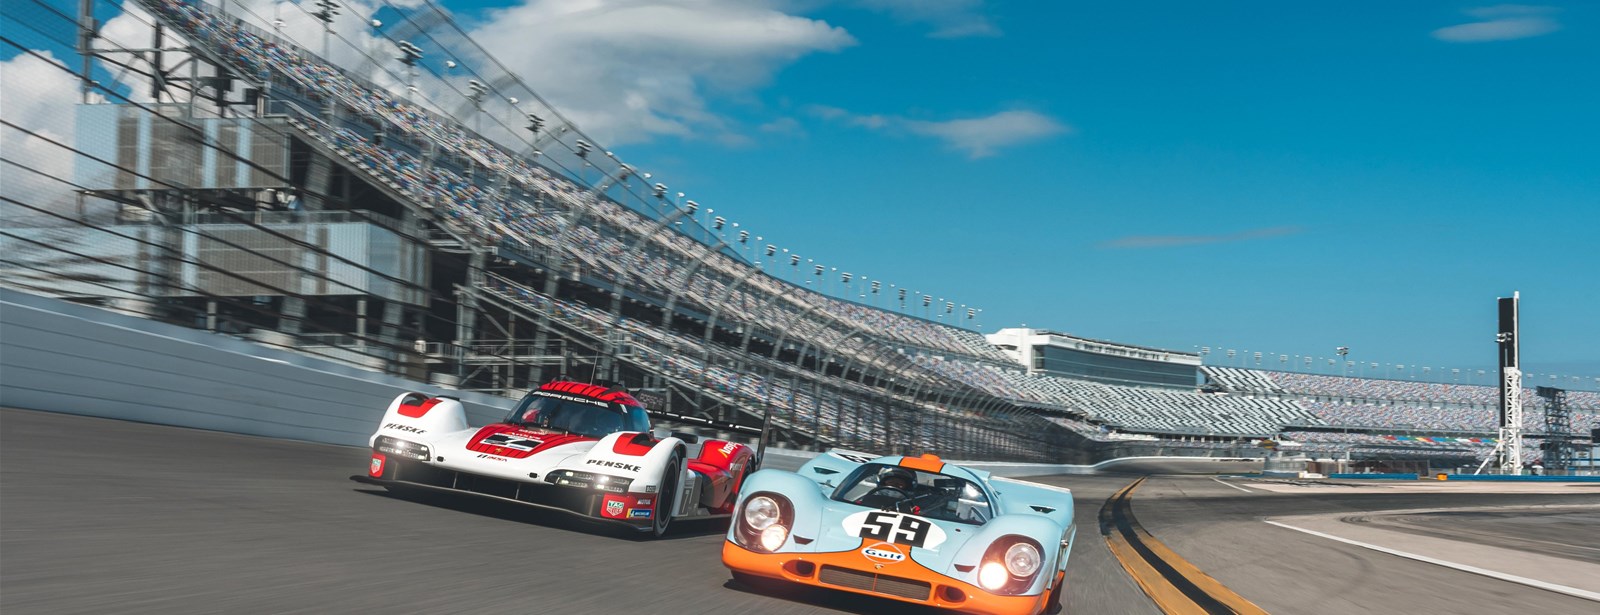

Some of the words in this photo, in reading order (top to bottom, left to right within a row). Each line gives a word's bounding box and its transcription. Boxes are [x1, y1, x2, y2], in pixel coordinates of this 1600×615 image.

[532, 391, 608, 408] PORSCHE
[383, 422, 427, 434] PENSKE
[586, 459, 641, 472] PENSKE
[859, 512, 932, 548] 59
[865, 549, 902, 560] Gulf
